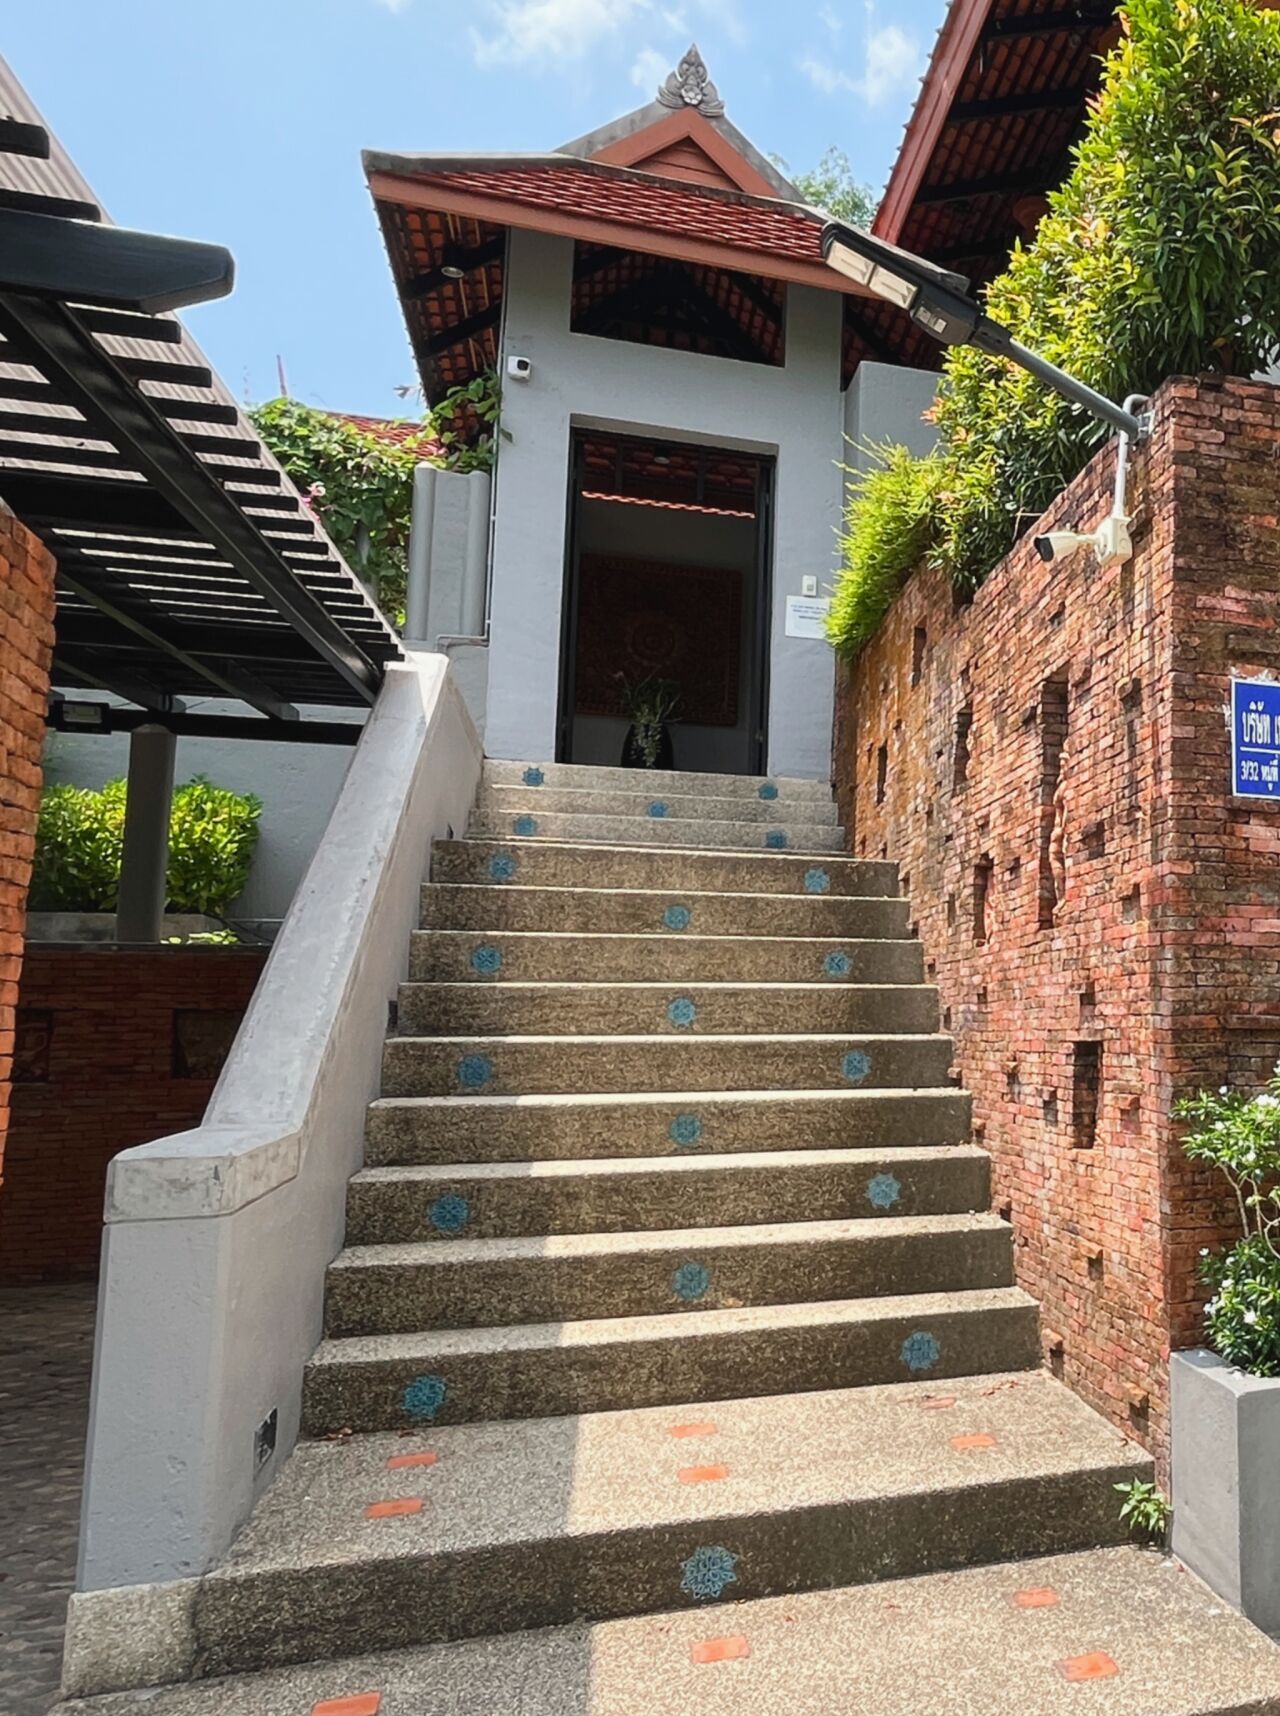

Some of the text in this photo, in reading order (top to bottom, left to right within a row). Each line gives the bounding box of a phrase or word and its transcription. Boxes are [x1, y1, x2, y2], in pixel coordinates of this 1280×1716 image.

[1242, 701, 1271, 745] บริษัท
[1240, 759, 1259, 781] 3/32
[1261, 754, 1279, 791] หมู่ที่
